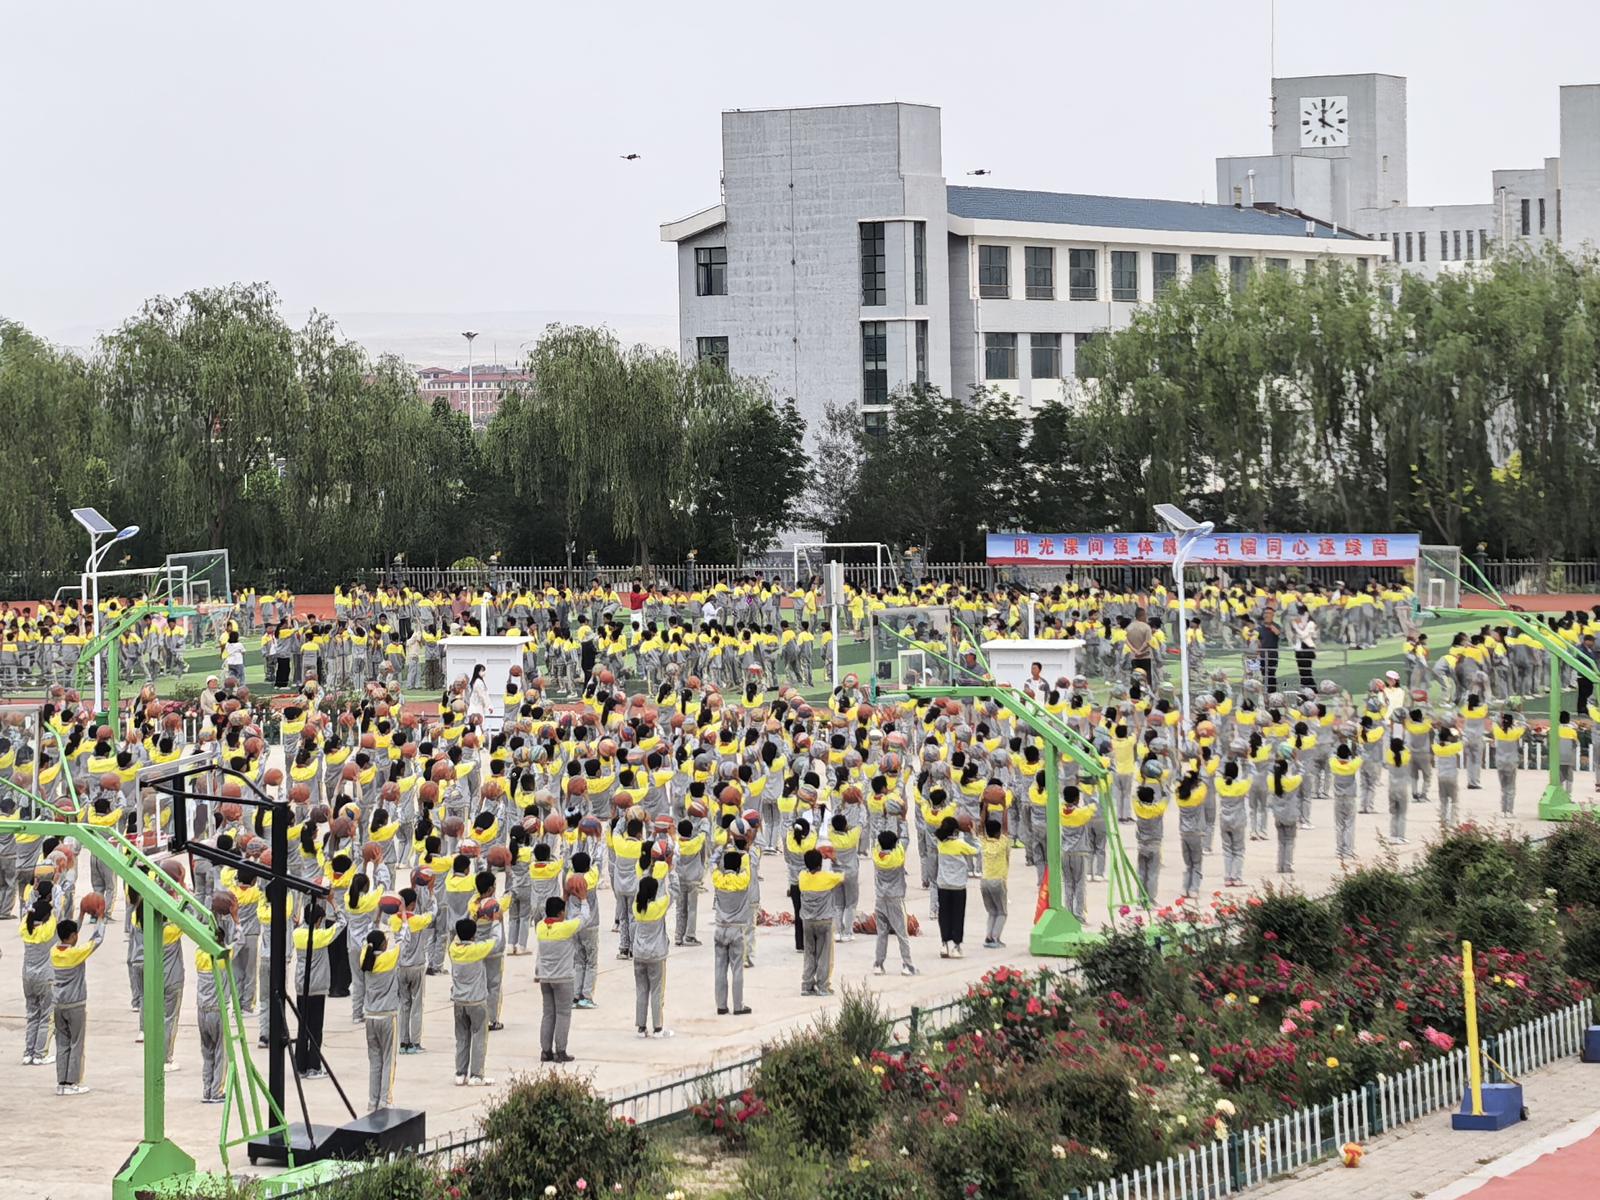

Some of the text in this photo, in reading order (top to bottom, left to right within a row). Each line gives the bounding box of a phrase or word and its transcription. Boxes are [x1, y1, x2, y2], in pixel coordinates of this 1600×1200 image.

[1014, 537, 1178, 556] 阳光课间强体魄
